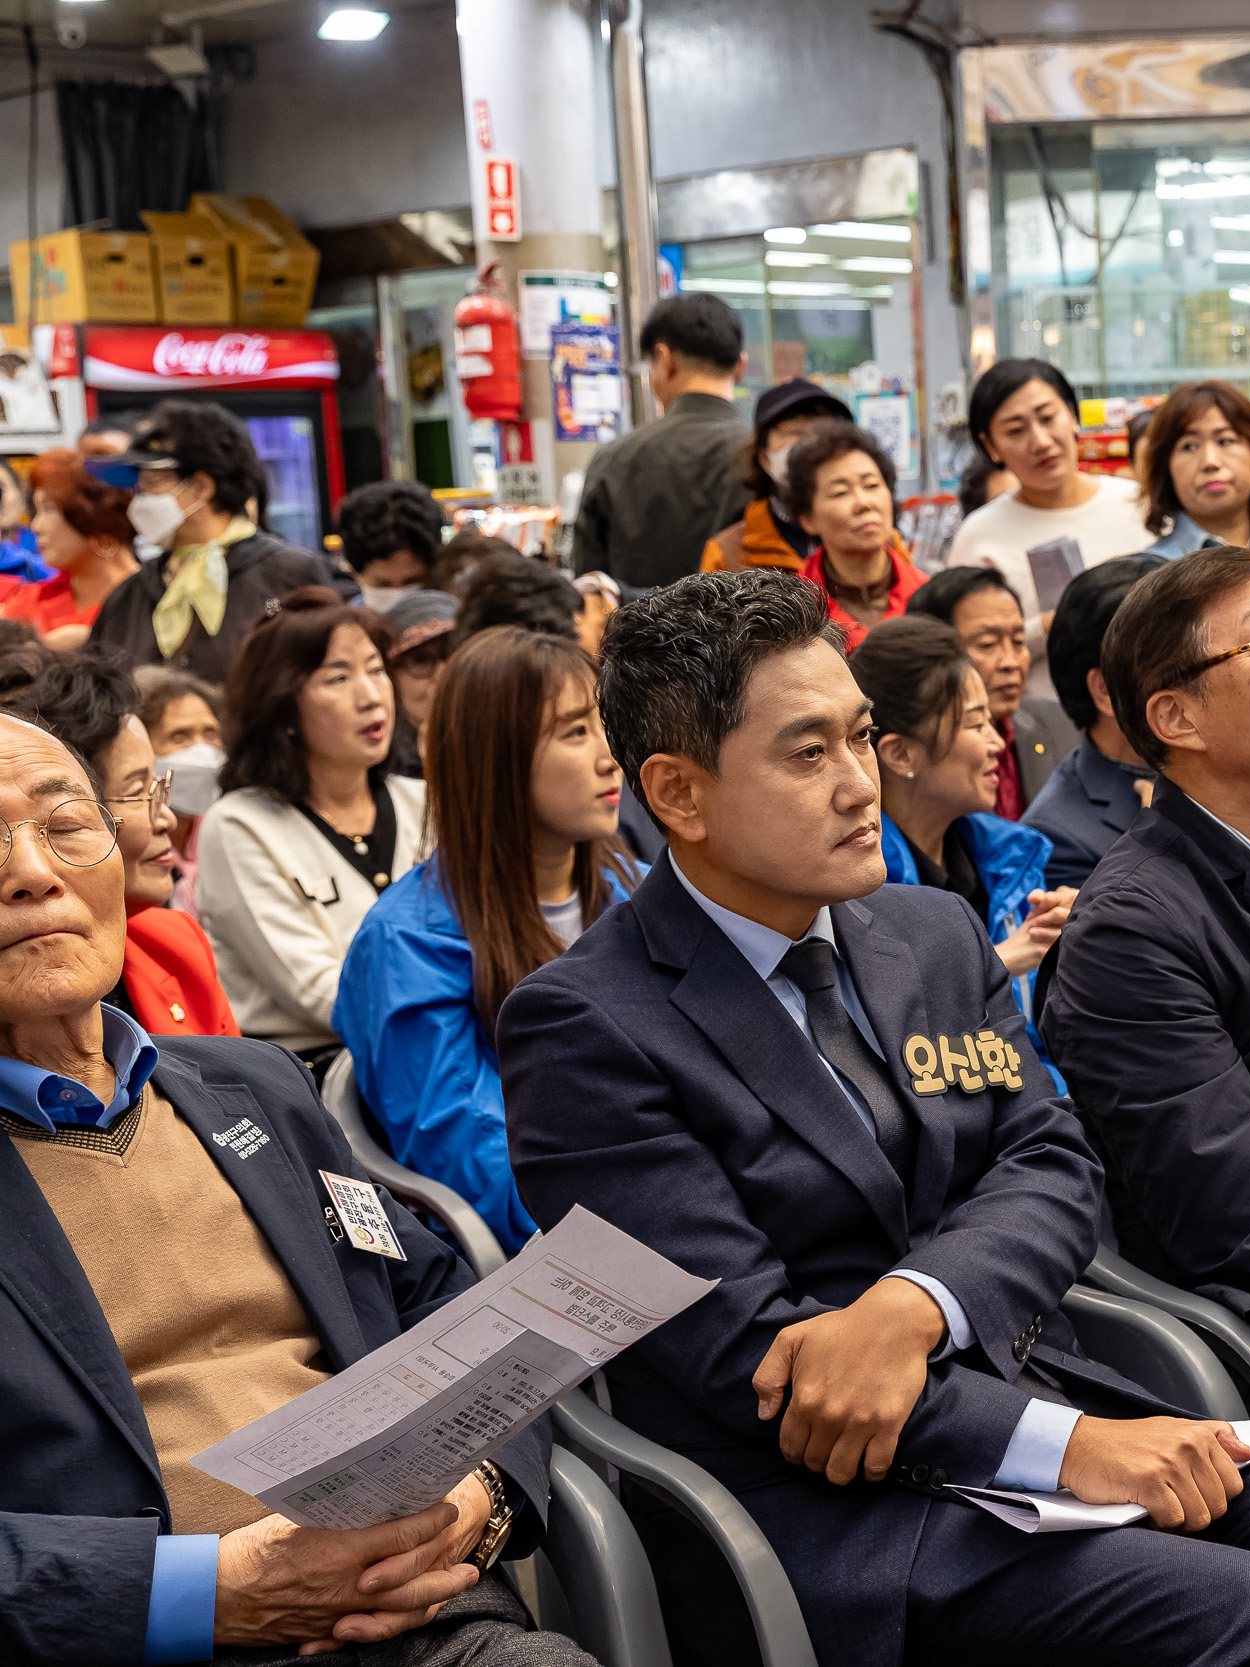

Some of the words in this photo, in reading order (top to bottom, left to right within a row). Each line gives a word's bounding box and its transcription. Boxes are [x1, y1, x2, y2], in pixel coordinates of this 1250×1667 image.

[905, 1030, 1023, 1093] 오신환
[331, 1181, 358, 1225] 민원해결방
[341, 1184, 367, 1227] 광진구의회
